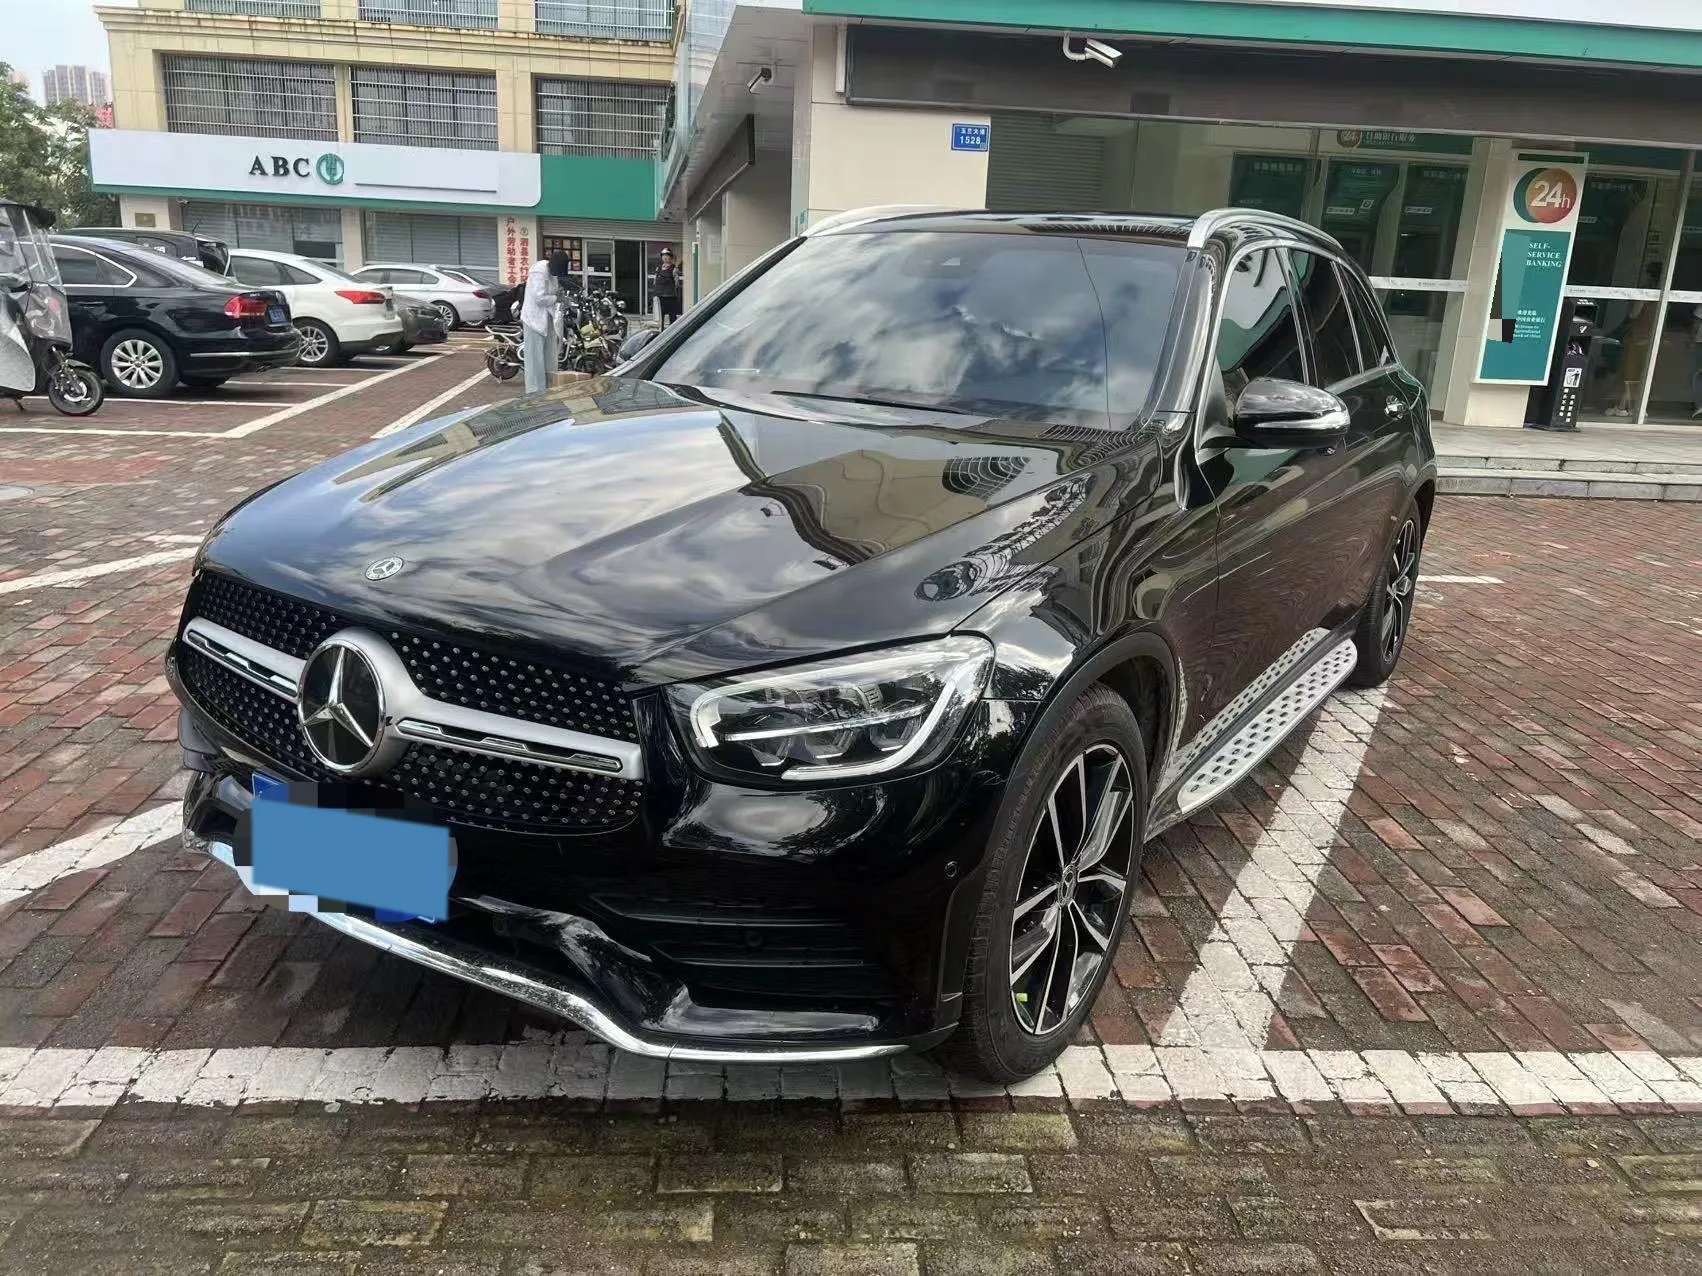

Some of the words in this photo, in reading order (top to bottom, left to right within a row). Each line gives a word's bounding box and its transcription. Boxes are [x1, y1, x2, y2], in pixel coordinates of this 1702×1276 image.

[960, 136, 981, 145] 1528
[249, 155, 310, 178] ABC
[506, 215, 517, 287] 户外劳动者工会
[1527, 251, 1561, 259] SERVICE
[1526, 260, 1562, 268] BANKING
